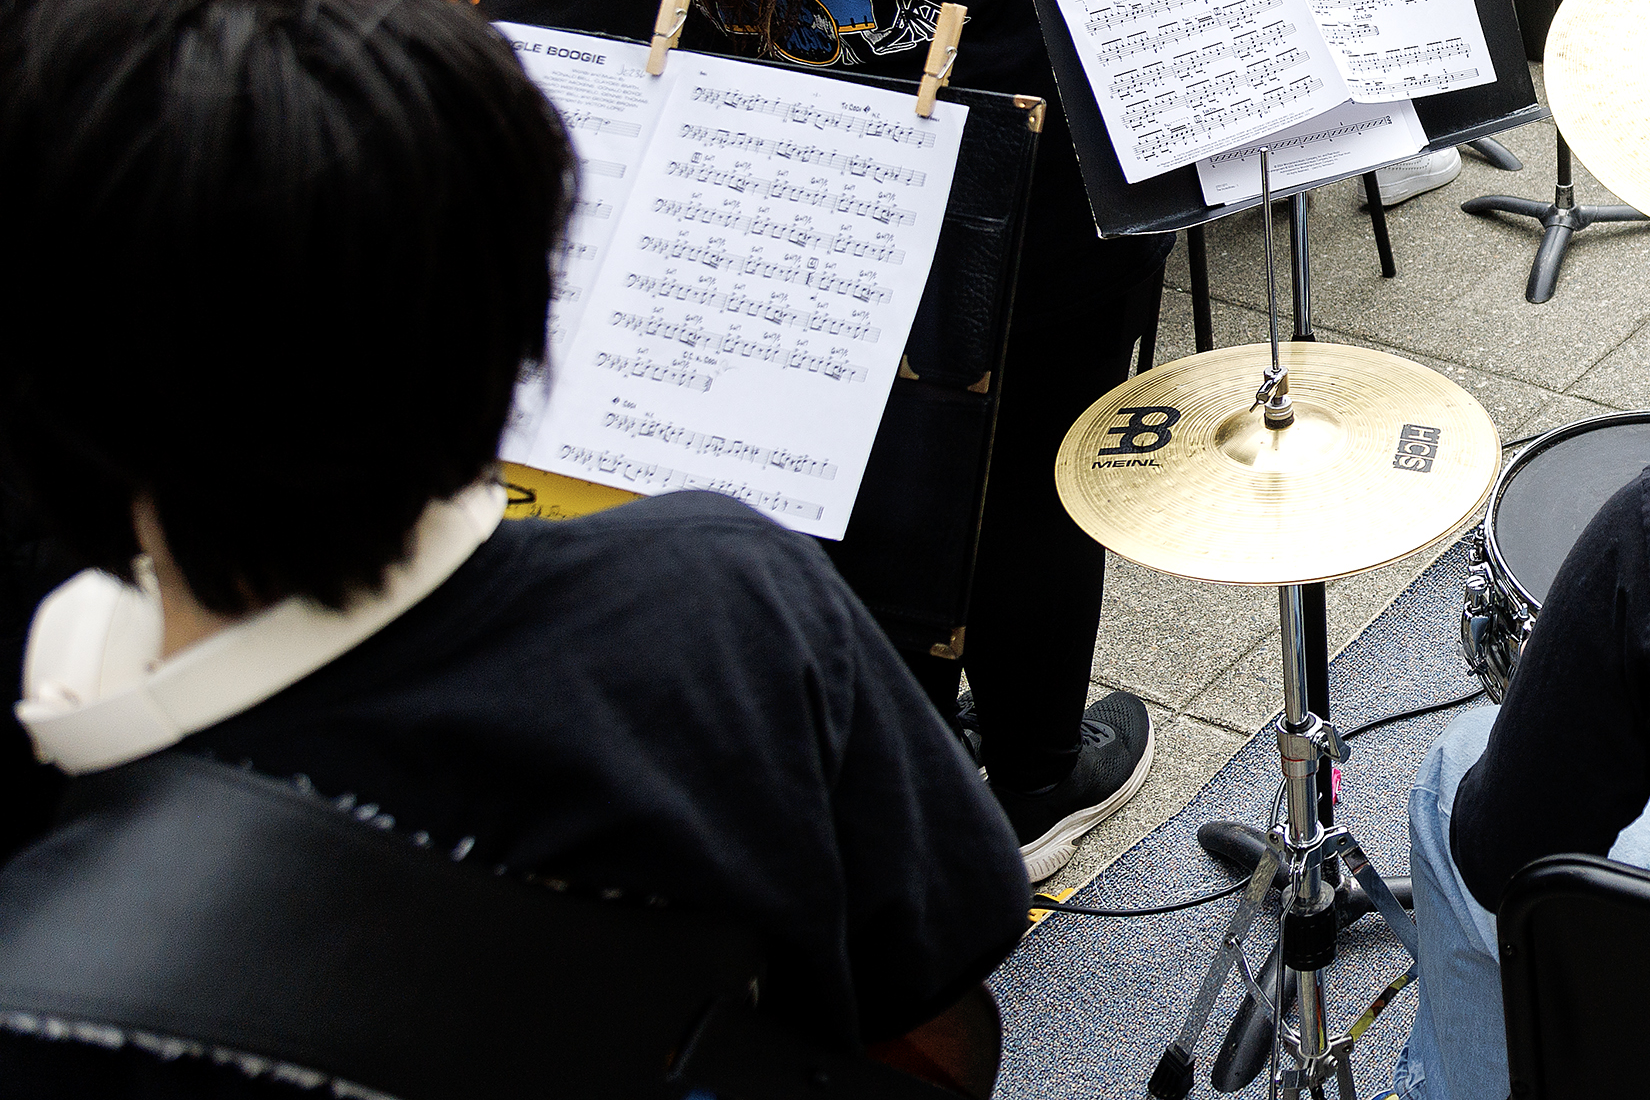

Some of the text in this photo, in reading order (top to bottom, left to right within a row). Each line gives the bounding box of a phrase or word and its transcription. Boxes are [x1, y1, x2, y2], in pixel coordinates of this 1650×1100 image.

[511, 40, 607, 65] GLE BOOGIE
[1394, 424, 1440, 472] HCS
[1091, 459, 1160, 470] MEINL
